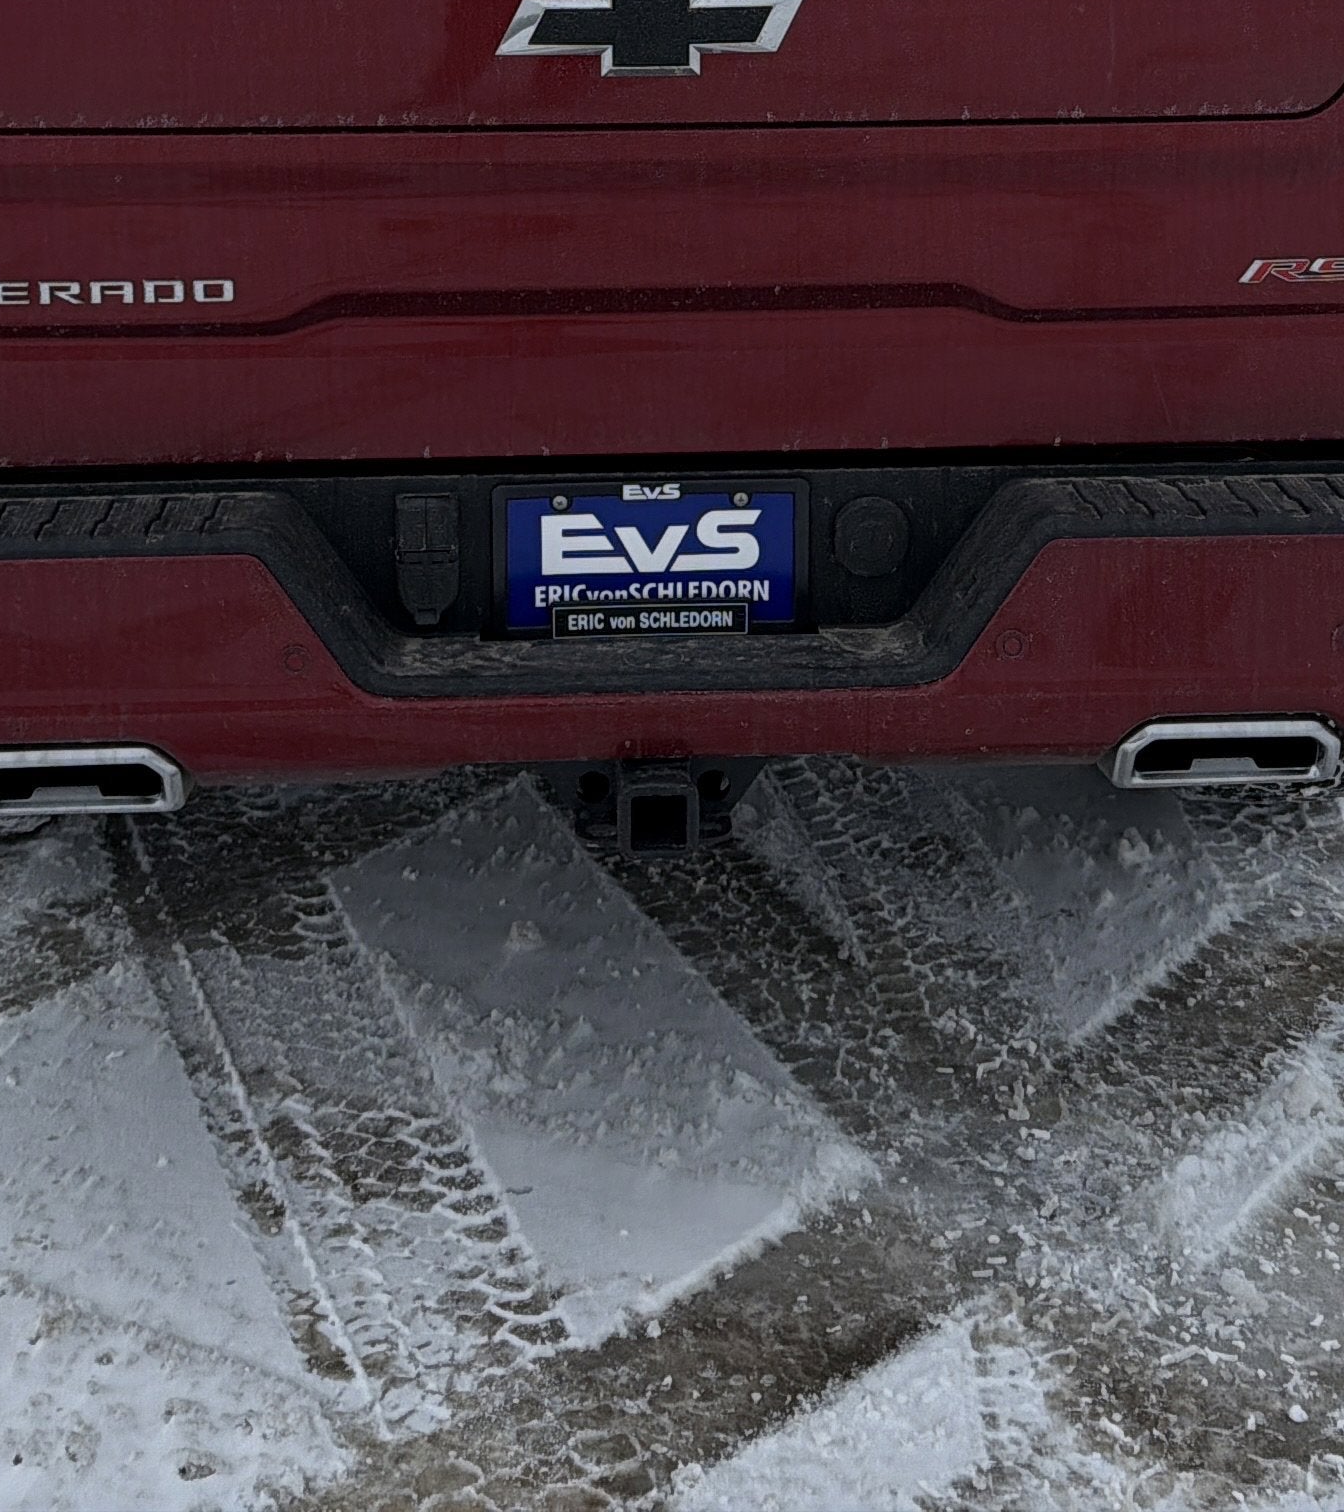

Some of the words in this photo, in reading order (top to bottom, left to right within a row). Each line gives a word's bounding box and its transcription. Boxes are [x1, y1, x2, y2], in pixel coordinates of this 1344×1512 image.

[567, 613, 605, 631] ERIC
[609, 614, 636, 630] von
[639, 610, 734, 629] SCHLEDORN
